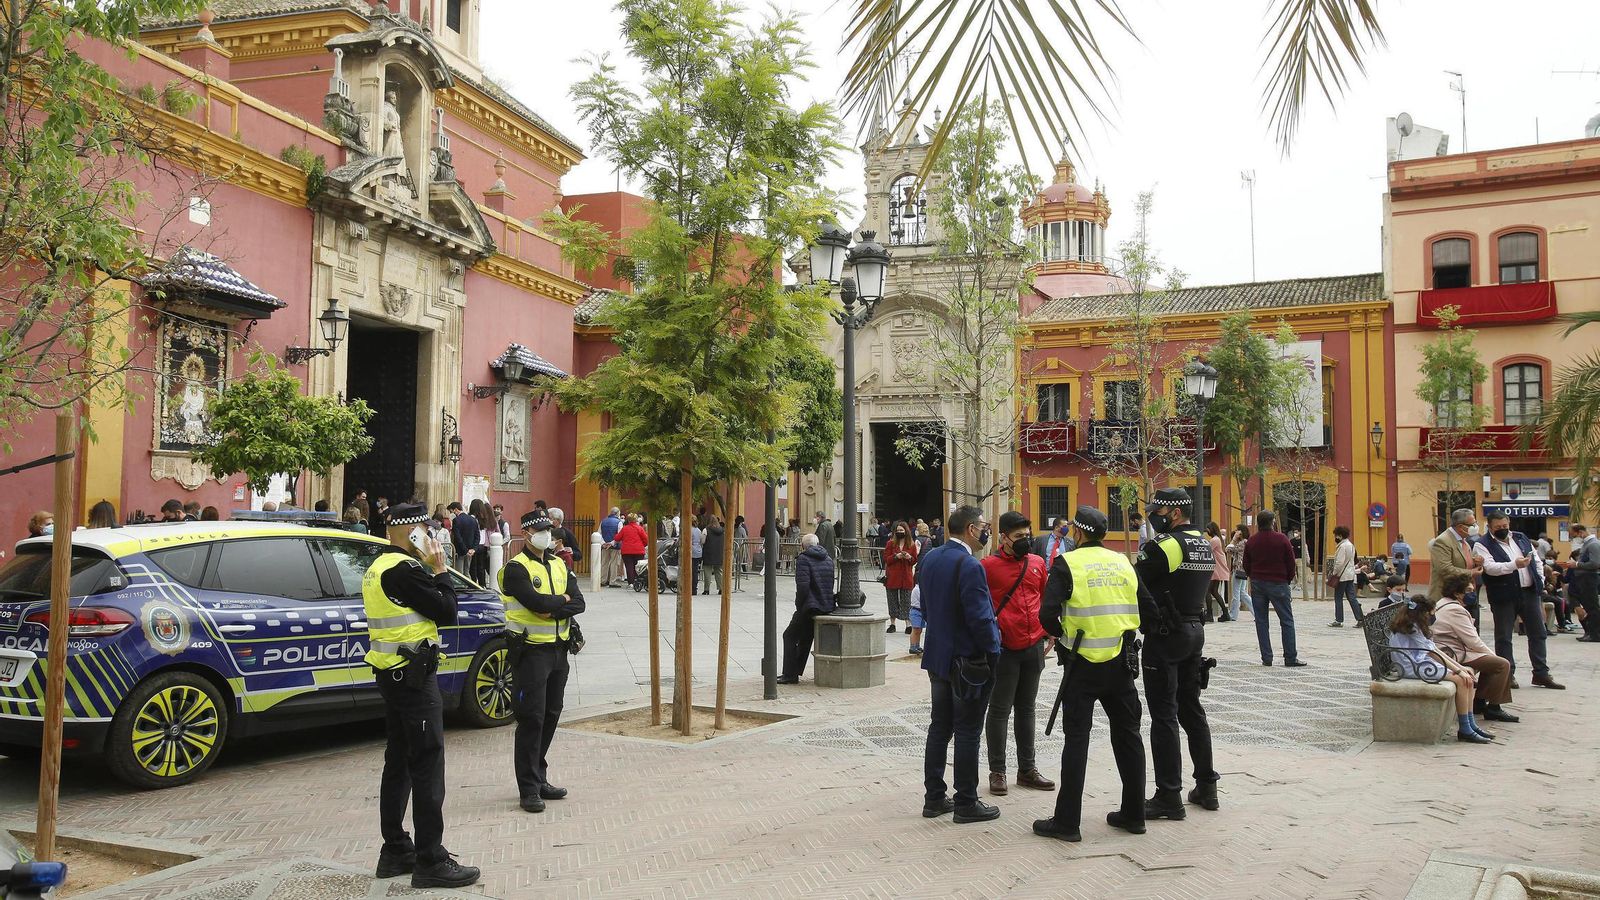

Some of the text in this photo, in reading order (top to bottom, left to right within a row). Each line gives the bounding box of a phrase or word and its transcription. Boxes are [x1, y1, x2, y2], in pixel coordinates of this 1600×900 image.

[1497, 507, 1554, 515] OTERIAS
[150, 533, 230, 544] SEVILLA
[1086, 577, 1129, 588] SEVILLA
[190, 641, 213, 649] 409
[263, 640, 367, 666] POLICÍA
[1, 661, 15, 676] JZ
